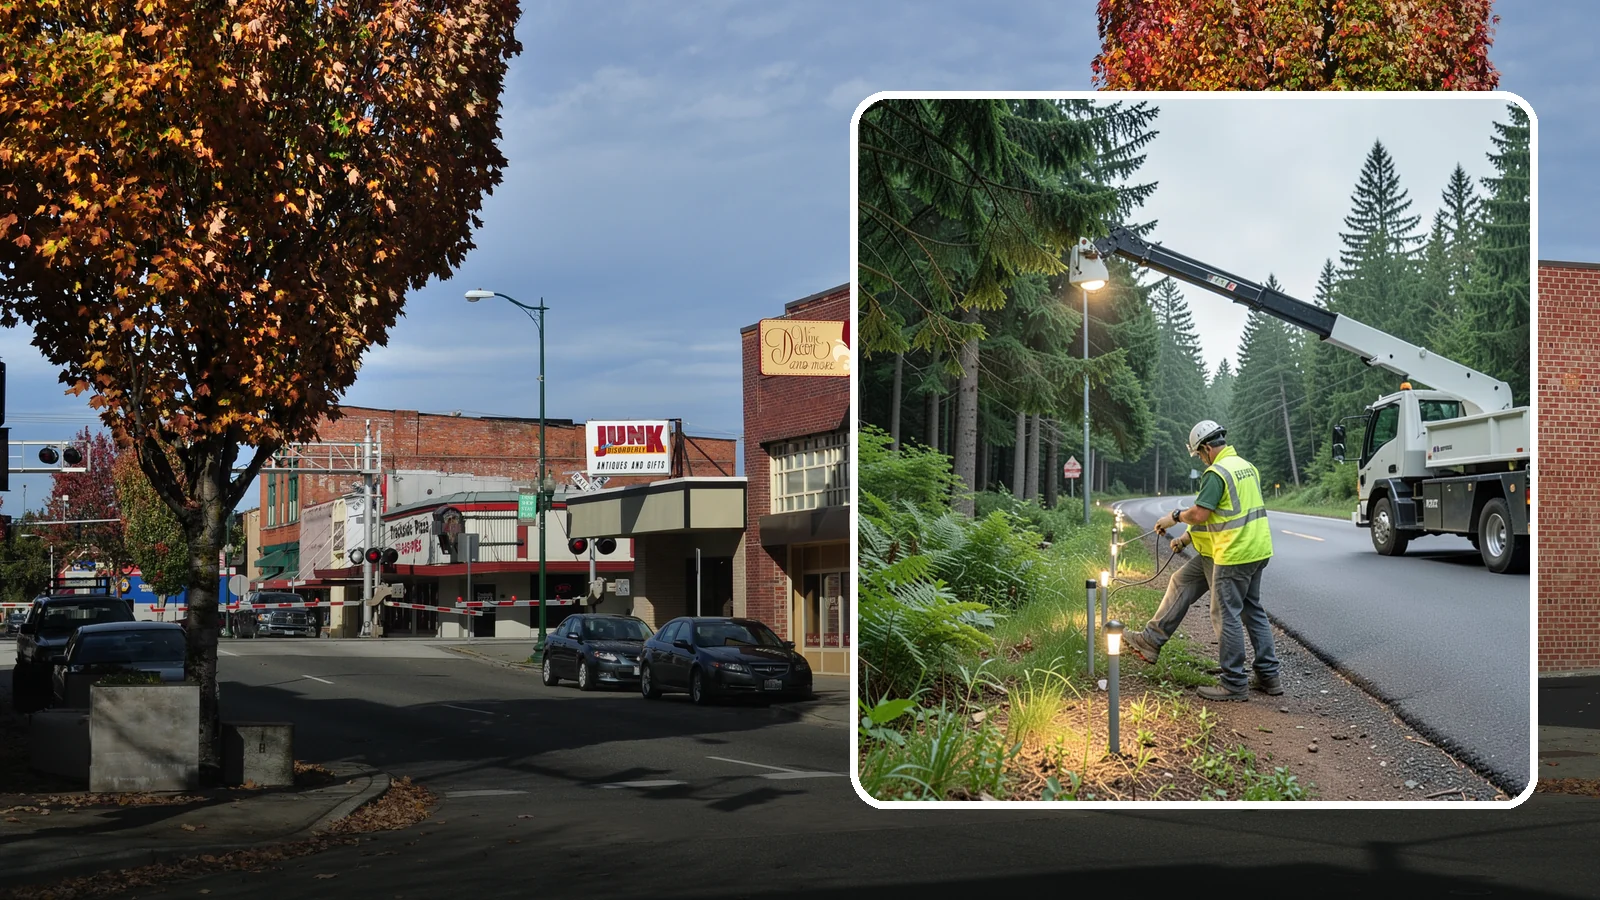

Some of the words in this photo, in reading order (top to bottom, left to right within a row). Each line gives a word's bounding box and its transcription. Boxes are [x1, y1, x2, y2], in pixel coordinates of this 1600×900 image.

[765, 327, 831, 365] Decor
[595, 425, 665, 457] JUNK
[607, 446, 646, 454] DISORDERLY
[597, 461, 628, 470] ANTIQUES
[631, 461, 644, 470] AND
[647, 460, 665, 470] GIFTS
[414, 519, 429, 535] Pizza
